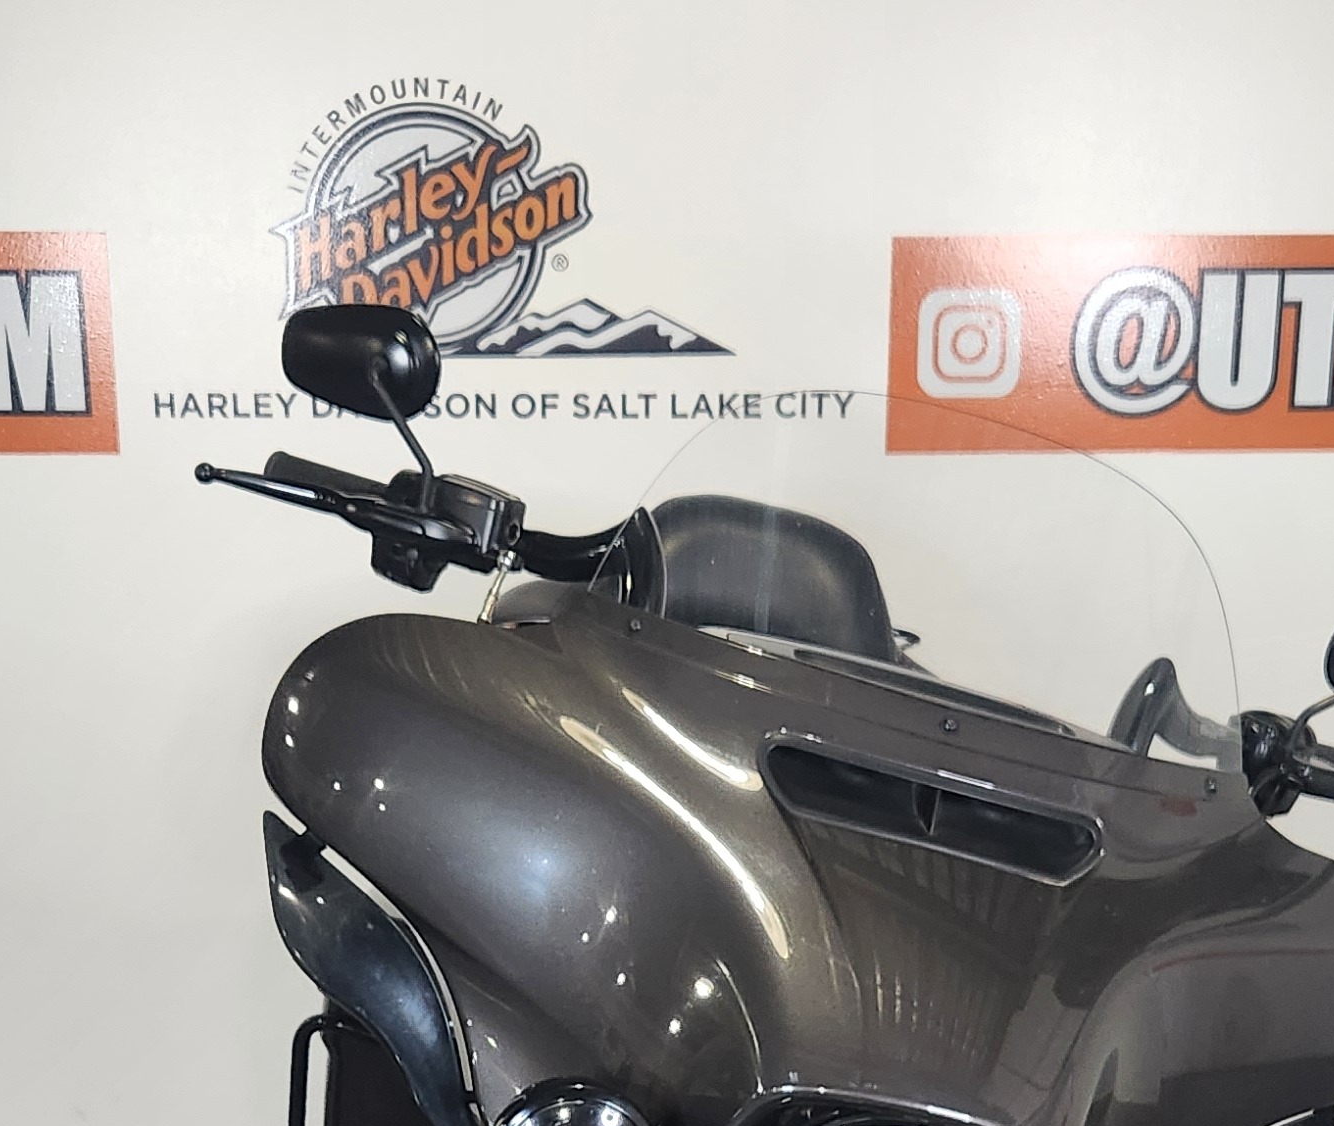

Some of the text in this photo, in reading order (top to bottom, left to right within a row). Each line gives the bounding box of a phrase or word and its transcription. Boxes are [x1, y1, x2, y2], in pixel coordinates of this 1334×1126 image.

[287, 76, 504, 194] INTERMOUNTAIN
[153, 391, 856, 420] HARLEY DSON OF SALT LAKE CITY
